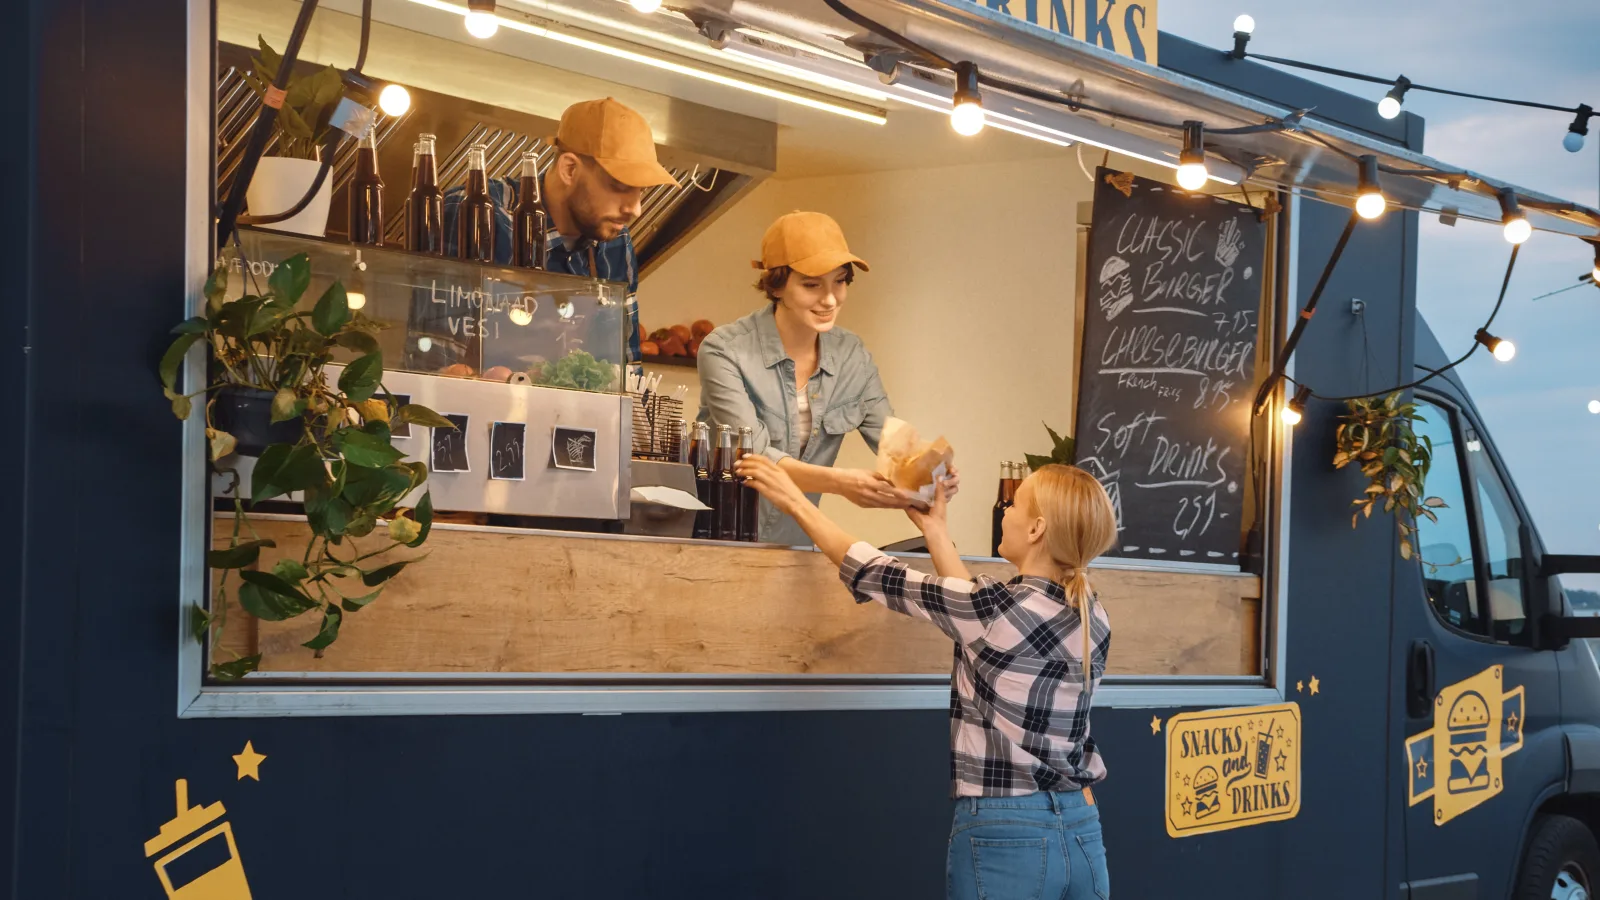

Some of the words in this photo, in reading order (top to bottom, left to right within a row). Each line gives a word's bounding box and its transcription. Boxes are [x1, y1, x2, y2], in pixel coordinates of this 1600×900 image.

[447, 316, 500, 339] VESI
[1180, 726, 1242, 758] SNACKS
[1222, 741, 1250, 777] and
[1231, 781, 1291, 815] DRINKS
